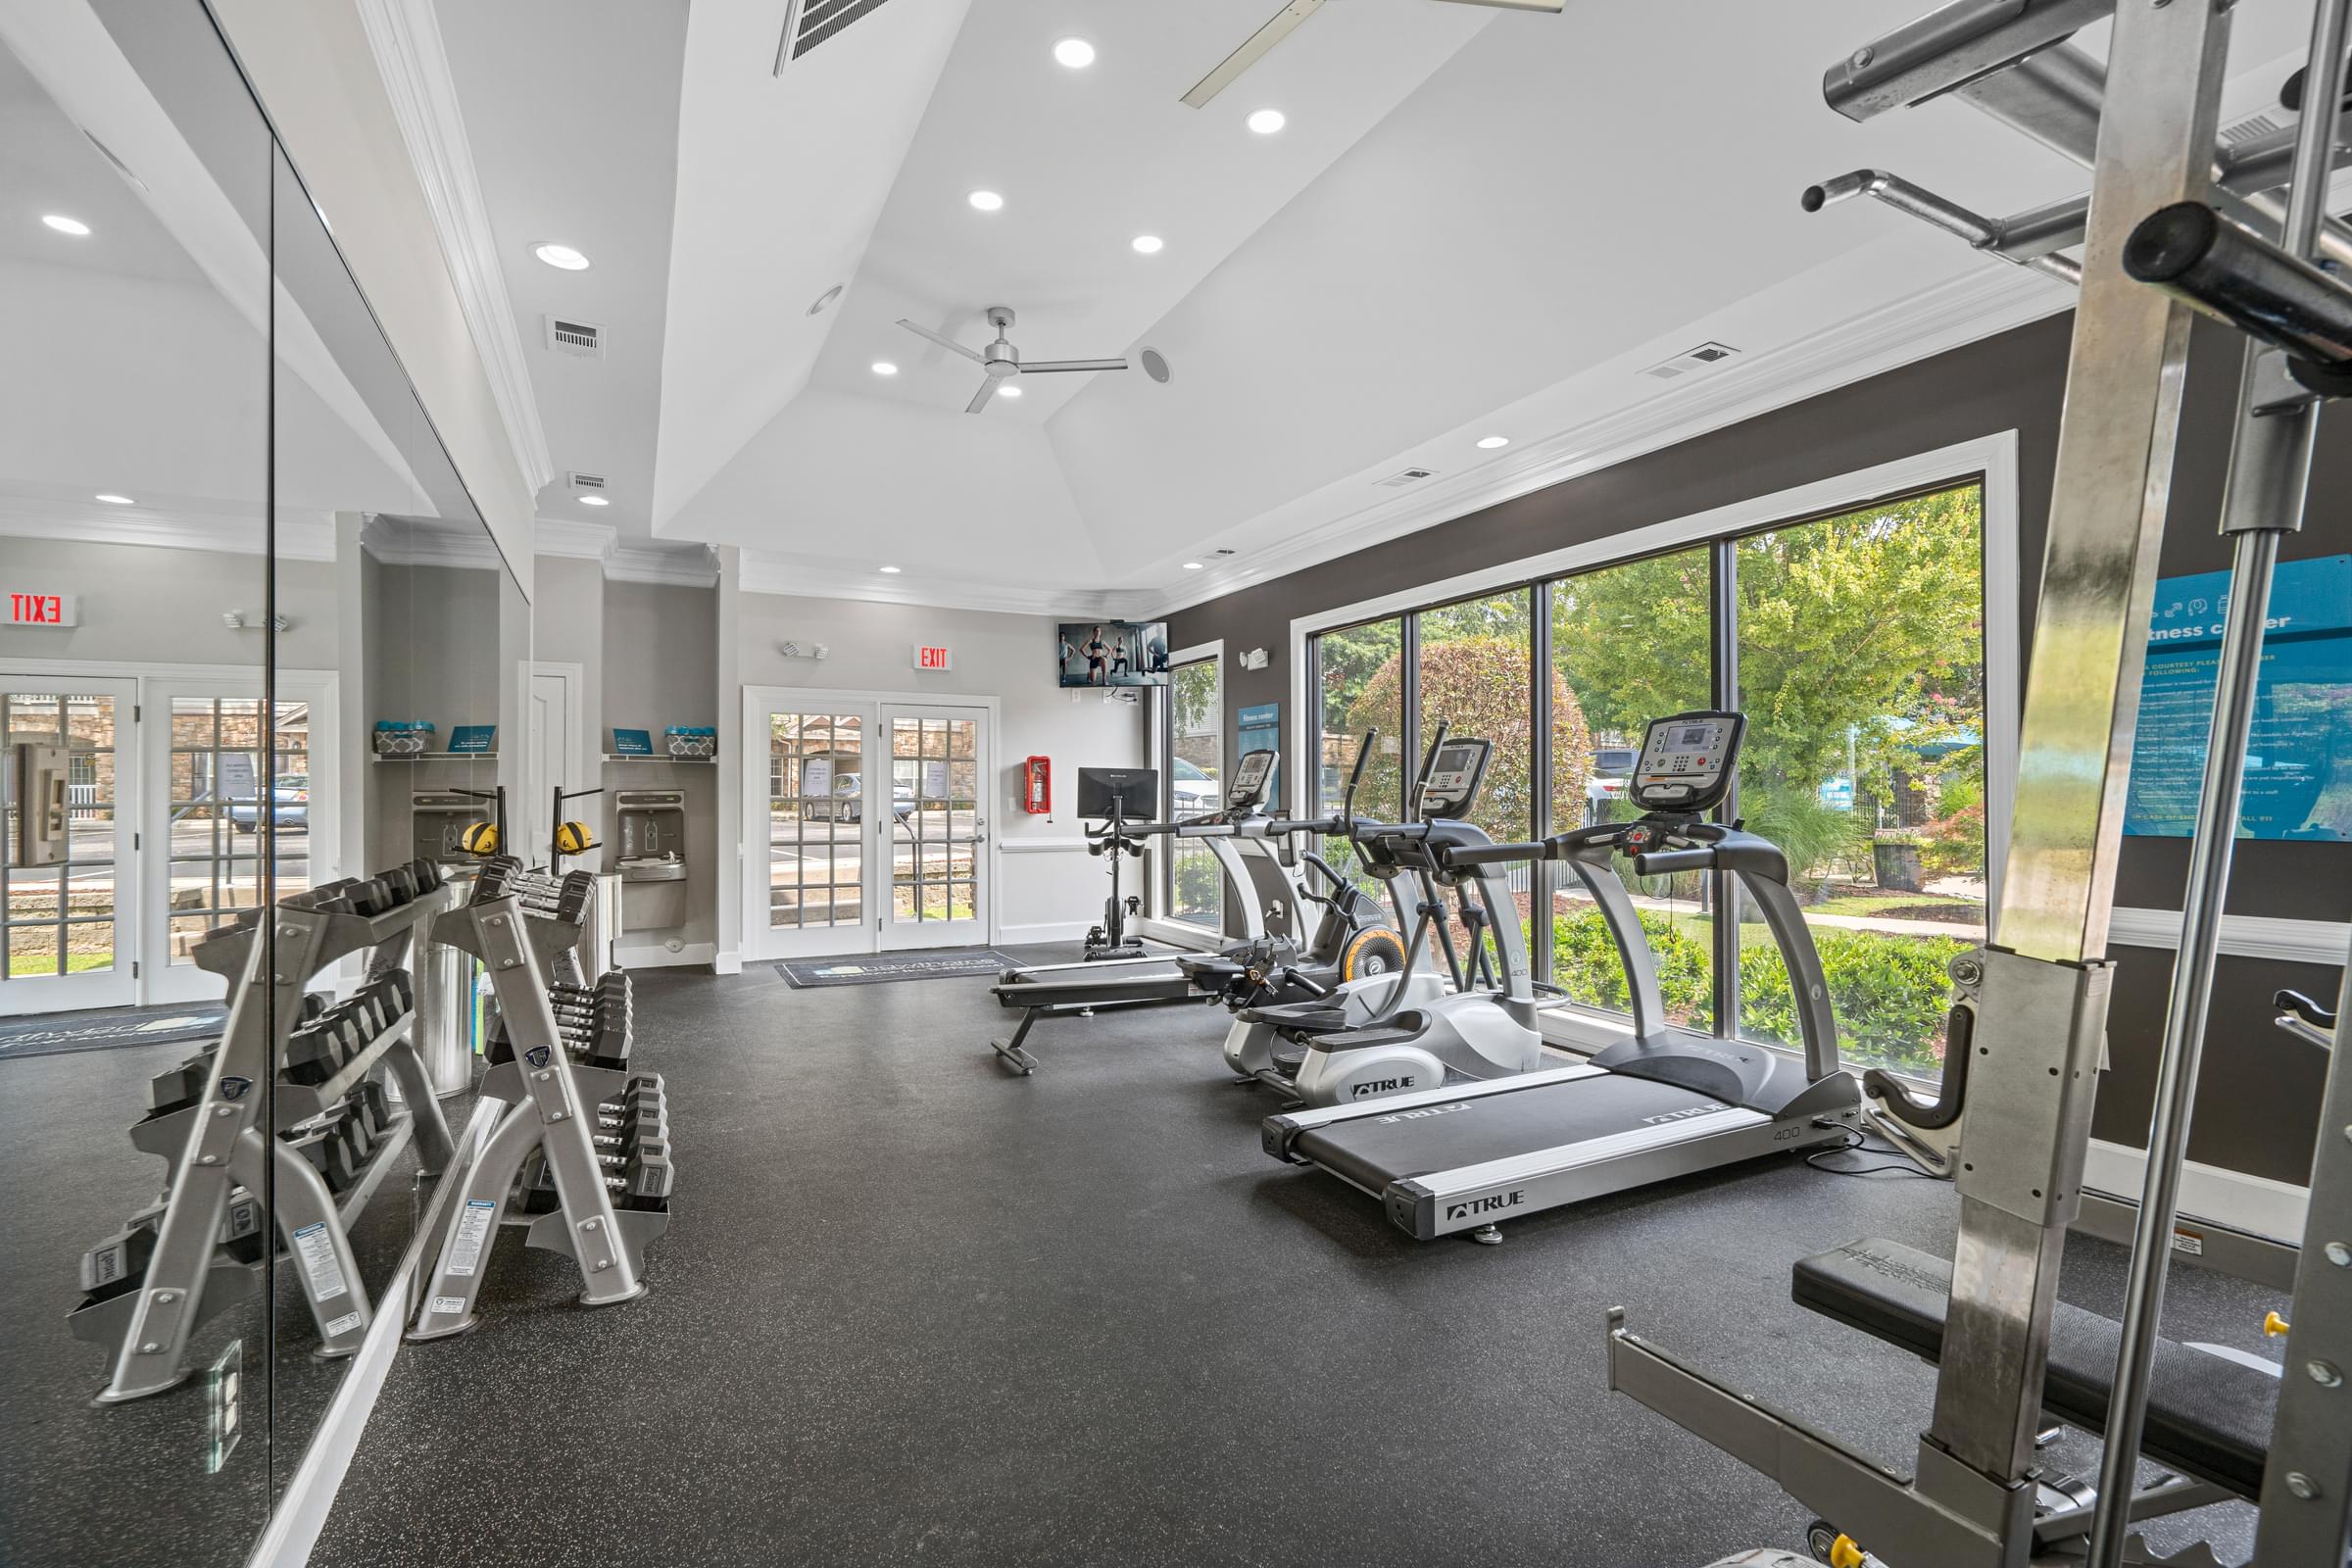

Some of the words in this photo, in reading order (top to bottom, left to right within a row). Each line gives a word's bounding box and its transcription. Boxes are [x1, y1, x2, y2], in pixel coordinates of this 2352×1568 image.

[921, 648, 947, 667] EXIT
[1369, 1076, 1414, 1093] TRUE
[1374, 1107, 1449, 1125] TRUE
[1773, 1127, 1799, 1142] 400
[1468, 1190, 1524, 1214] TRUE
